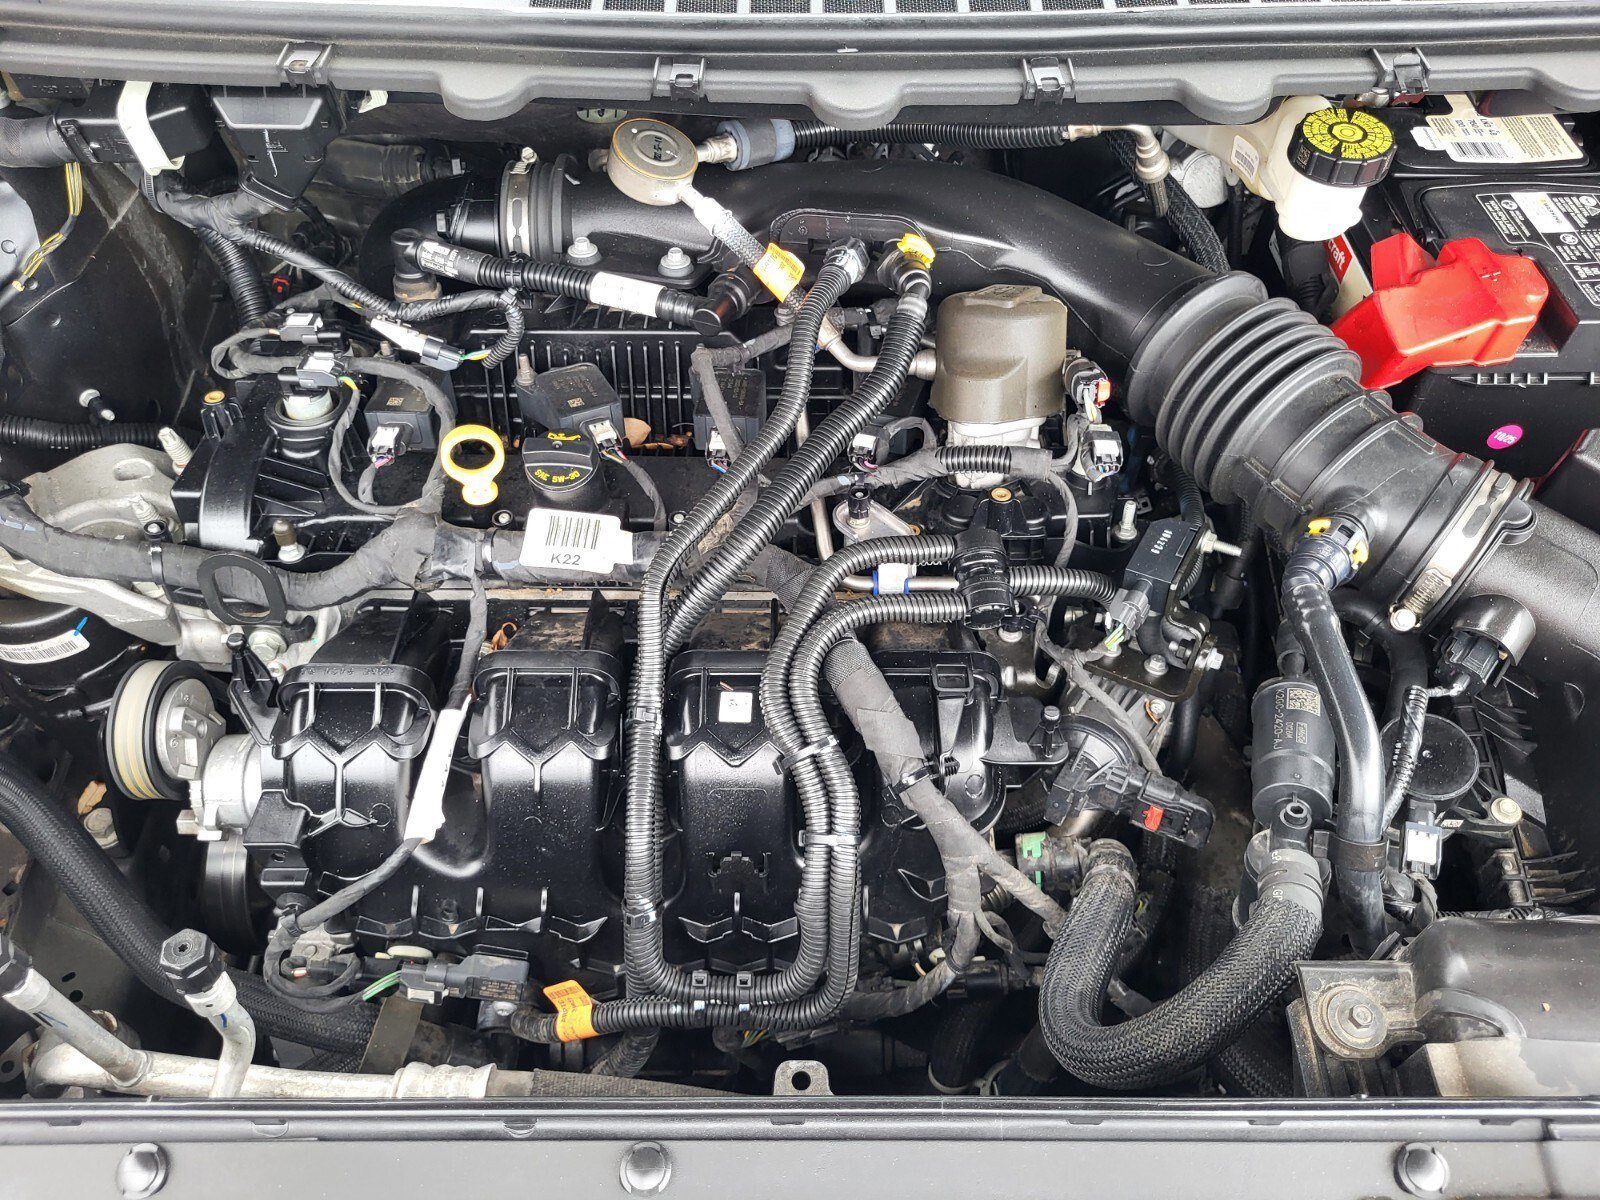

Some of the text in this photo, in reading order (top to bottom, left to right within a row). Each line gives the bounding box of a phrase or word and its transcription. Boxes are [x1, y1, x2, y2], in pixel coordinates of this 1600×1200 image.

[534, 468, 581, 483] SAE 5W-30
[551, 553, 581, 566] K22
